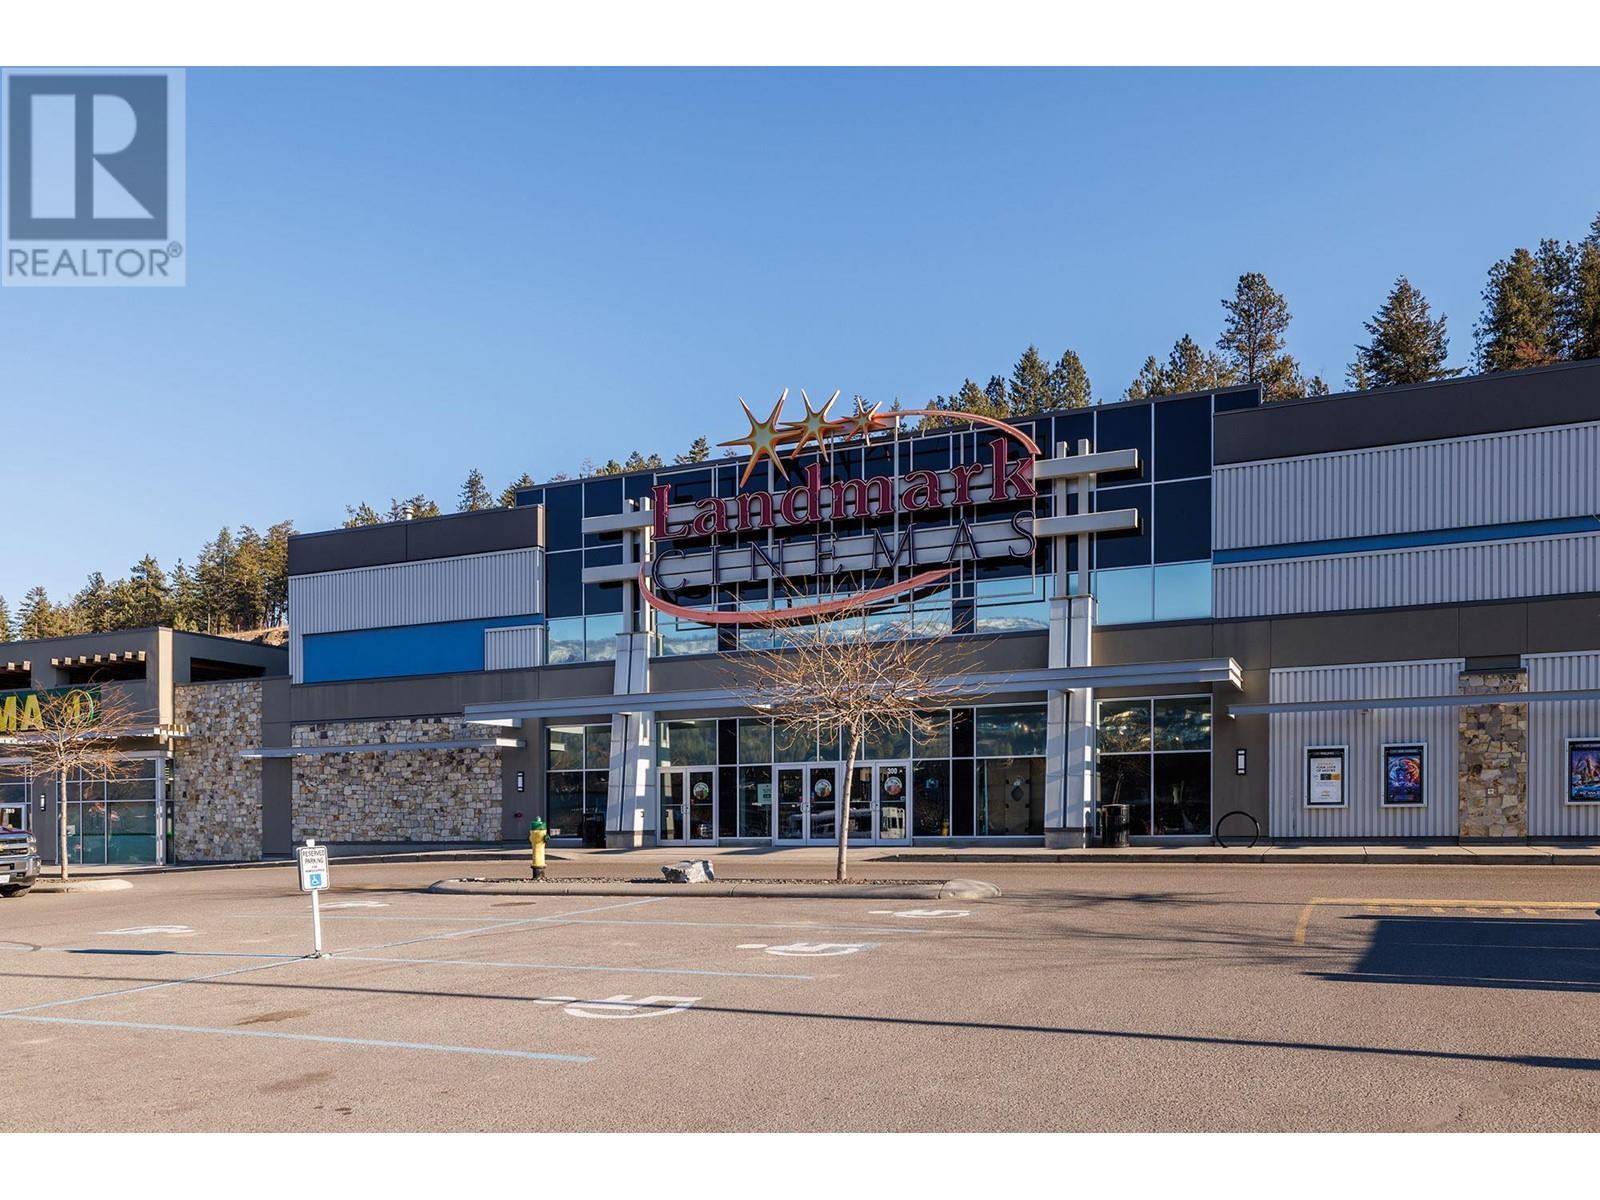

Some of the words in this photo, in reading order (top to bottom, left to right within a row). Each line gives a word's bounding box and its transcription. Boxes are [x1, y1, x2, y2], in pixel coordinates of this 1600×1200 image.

[651, 437, 1038, 541] Landmark
[651, 510, 1037, 592] CINEMAS
[302, 849, 325, 857] RESERVED
